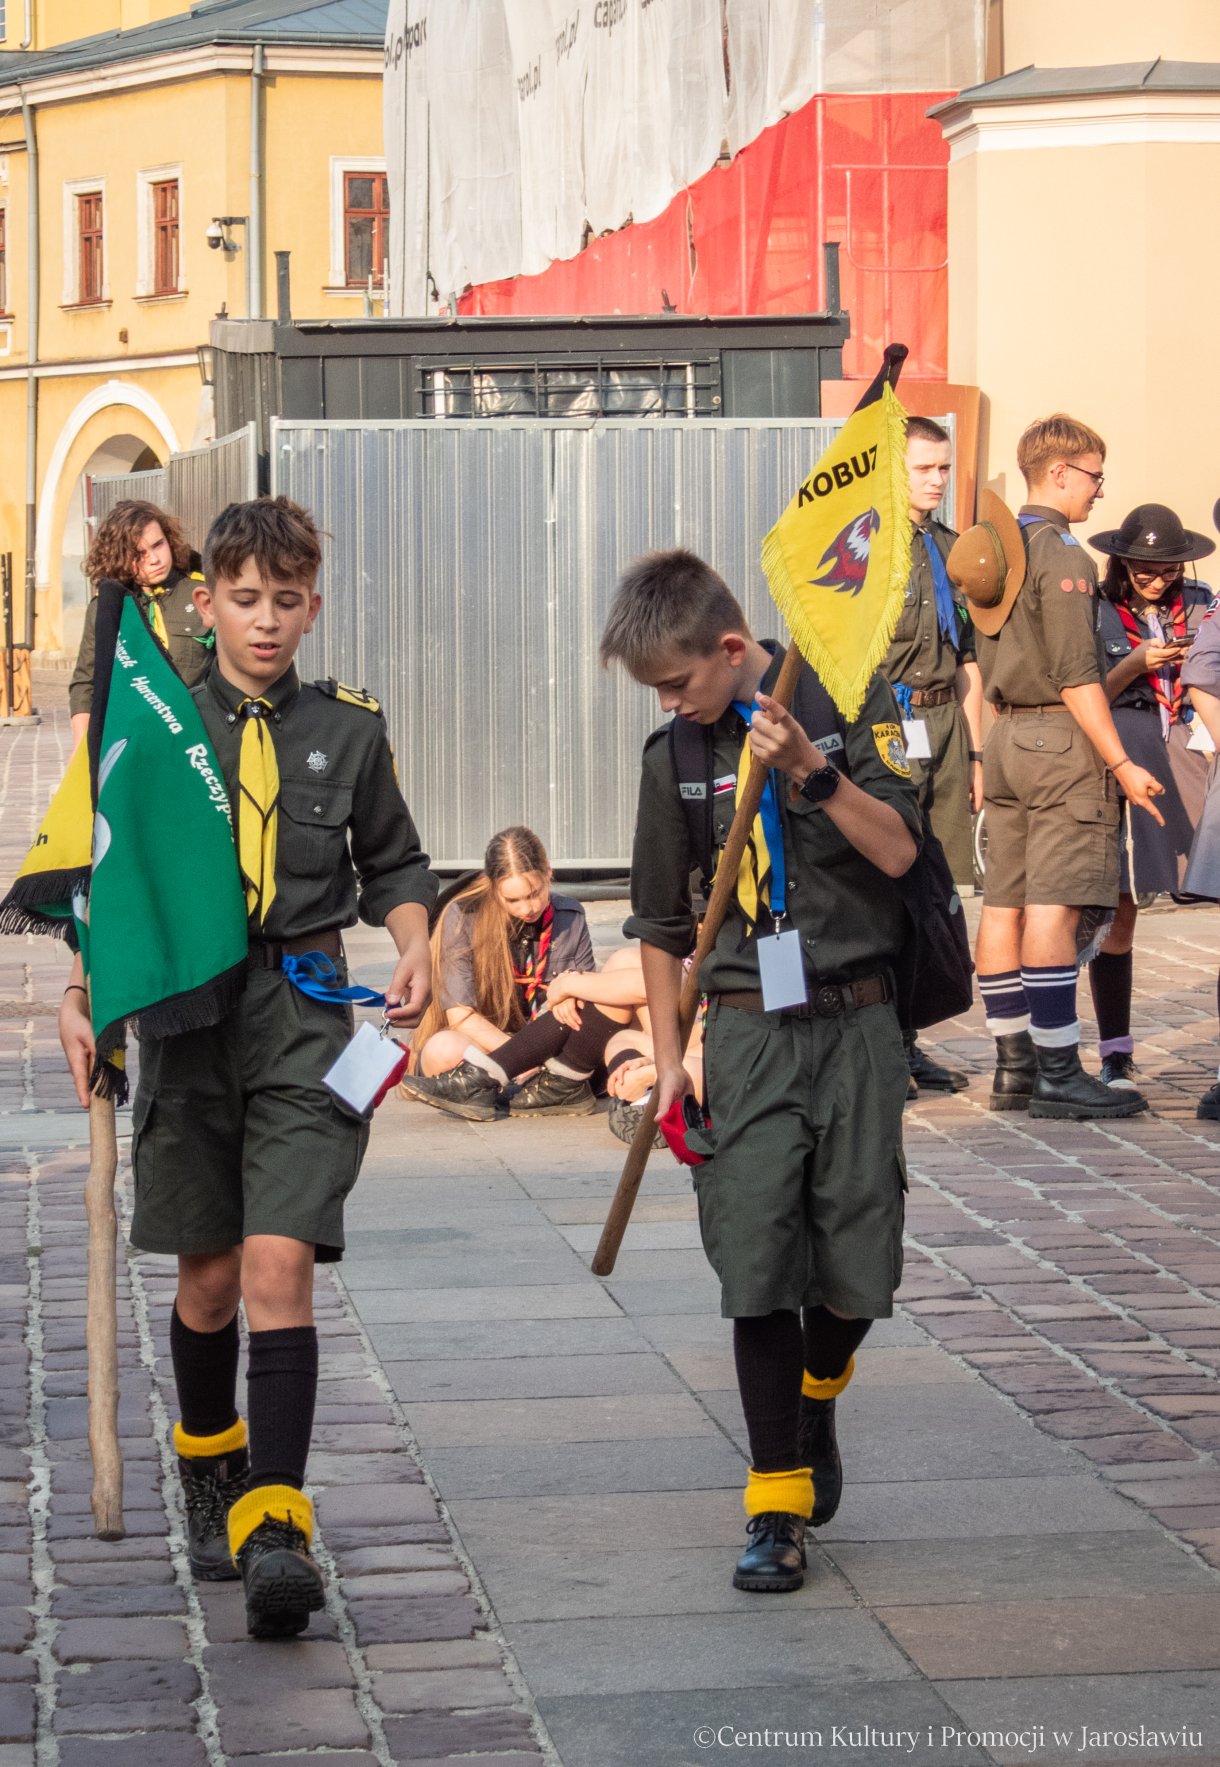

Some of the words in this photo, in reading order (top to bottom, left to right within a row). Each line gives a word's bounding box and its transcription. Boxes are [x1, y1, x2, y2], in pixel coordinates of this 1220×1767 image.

[130, 675, 184, 735] Harcerstwa
[184, 743, 235, 843] Rzeczyp
[681, 786, 703, 796] FILA
